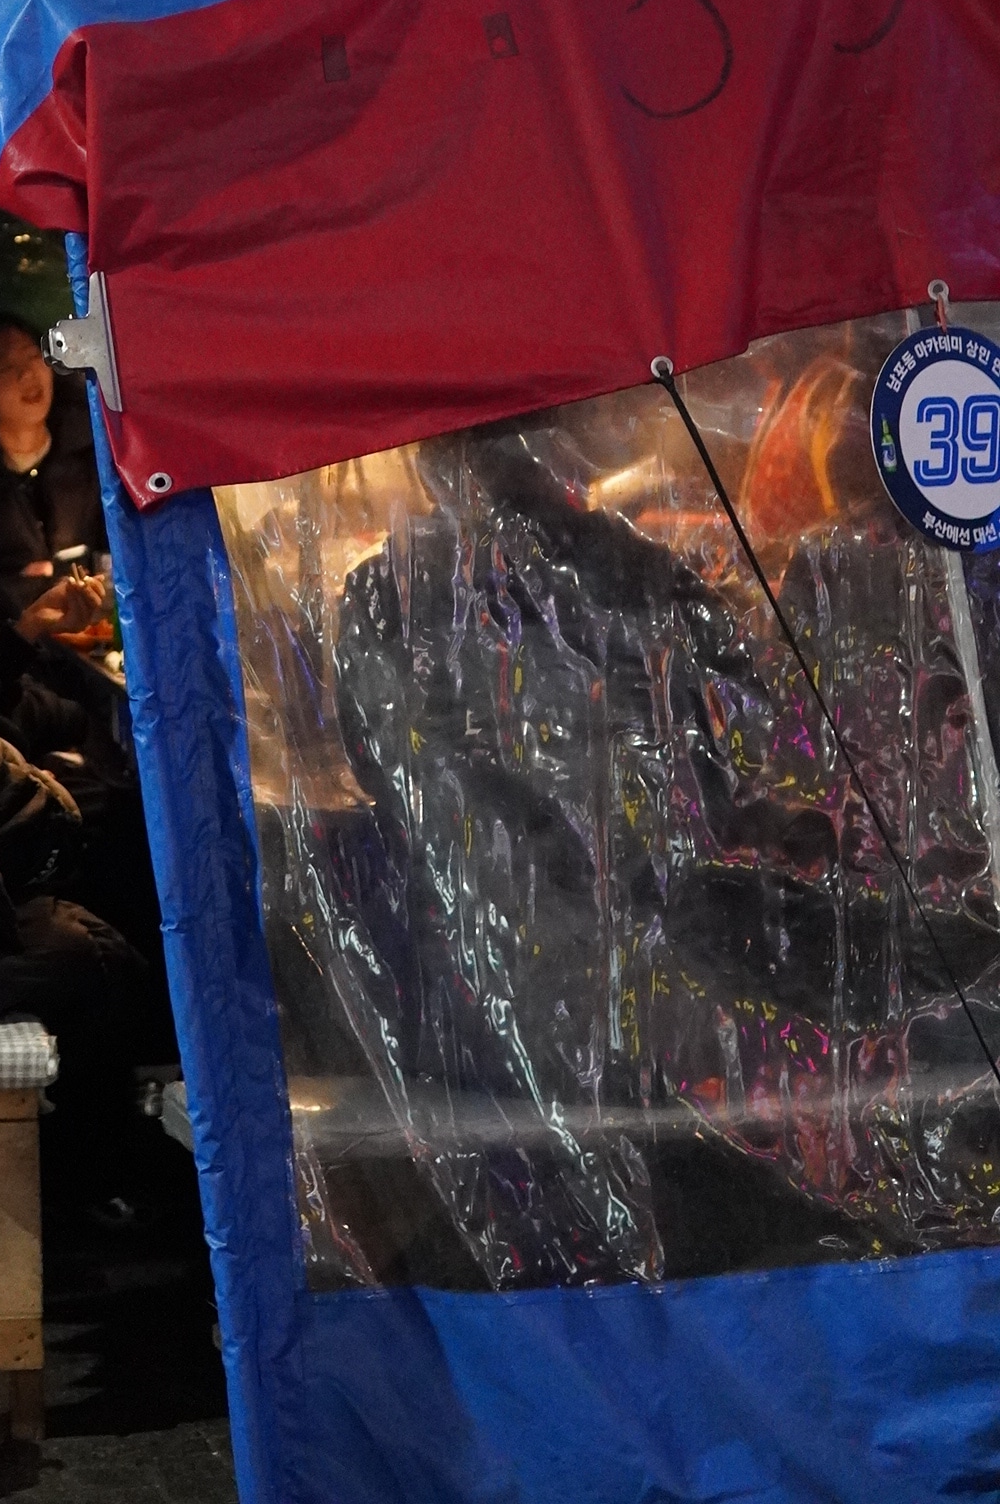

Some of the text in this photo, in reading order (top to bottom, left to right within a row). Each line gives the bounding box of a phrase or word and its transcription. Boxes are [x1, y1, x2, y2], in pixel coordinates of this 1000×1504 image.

[886, 335, 991, 393] 남포동 아카데미 상인
[914, 395, 1000, 487] 39
[922, 510, 998, 546] 부산에선 대선
